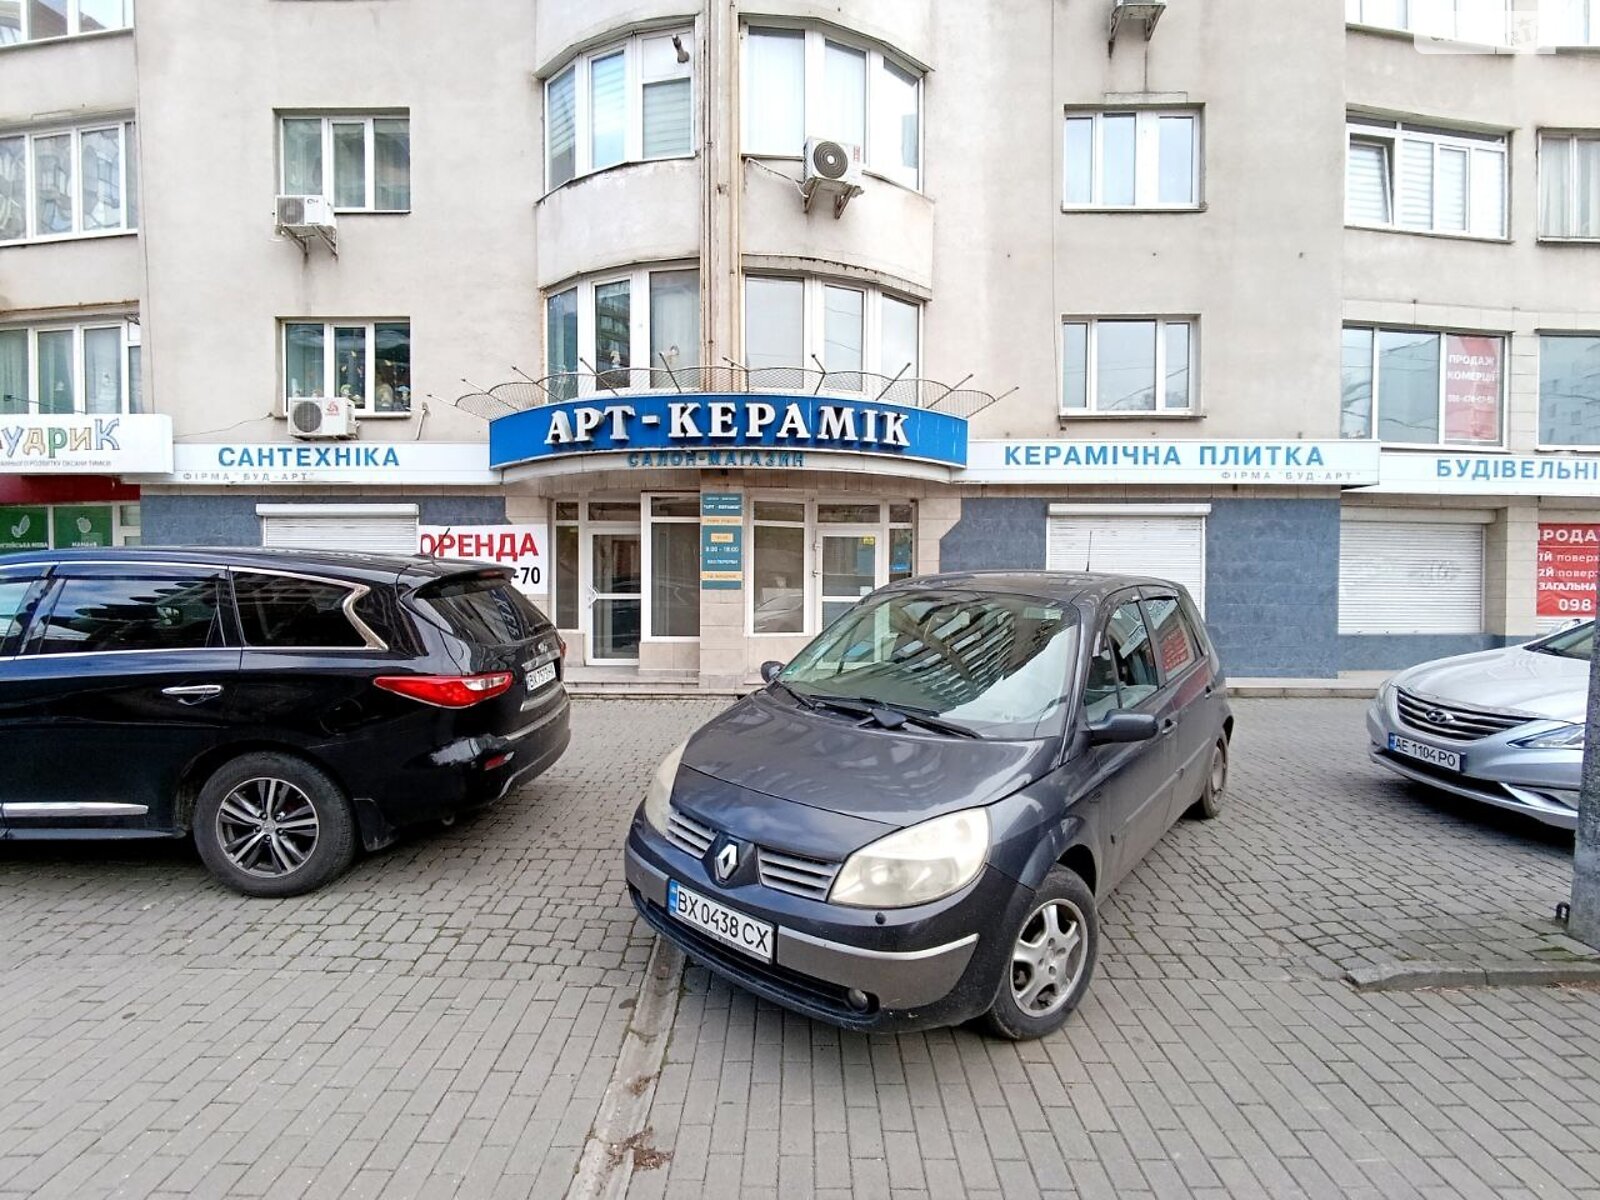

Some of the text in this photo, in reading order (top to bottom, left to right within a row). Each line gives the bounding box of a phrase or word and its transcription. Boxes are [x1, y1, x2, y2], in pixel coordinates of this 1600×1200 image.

[218, 447, 400, 467] САНТЕХНІКА
[1004, 445, 1325, 466] КЕРАМІЧНА ПЛИТКА
[183, 472, 230, 481] ФІРМА
[1221, 471, 1272, 480] ФІРМА
[1436, 459, 1598, 481] БУДІВЕЛЬНІ
[420, 532, 539, 562] ОРЕНДА
[1538, 582, 1597, 591] ЗАГАЛЬНА
[1558, 598, 1592, 611] 098
[1411, 743, 1436, 762] 1104
[678, 890, 769, 953] BX 0438 CX
